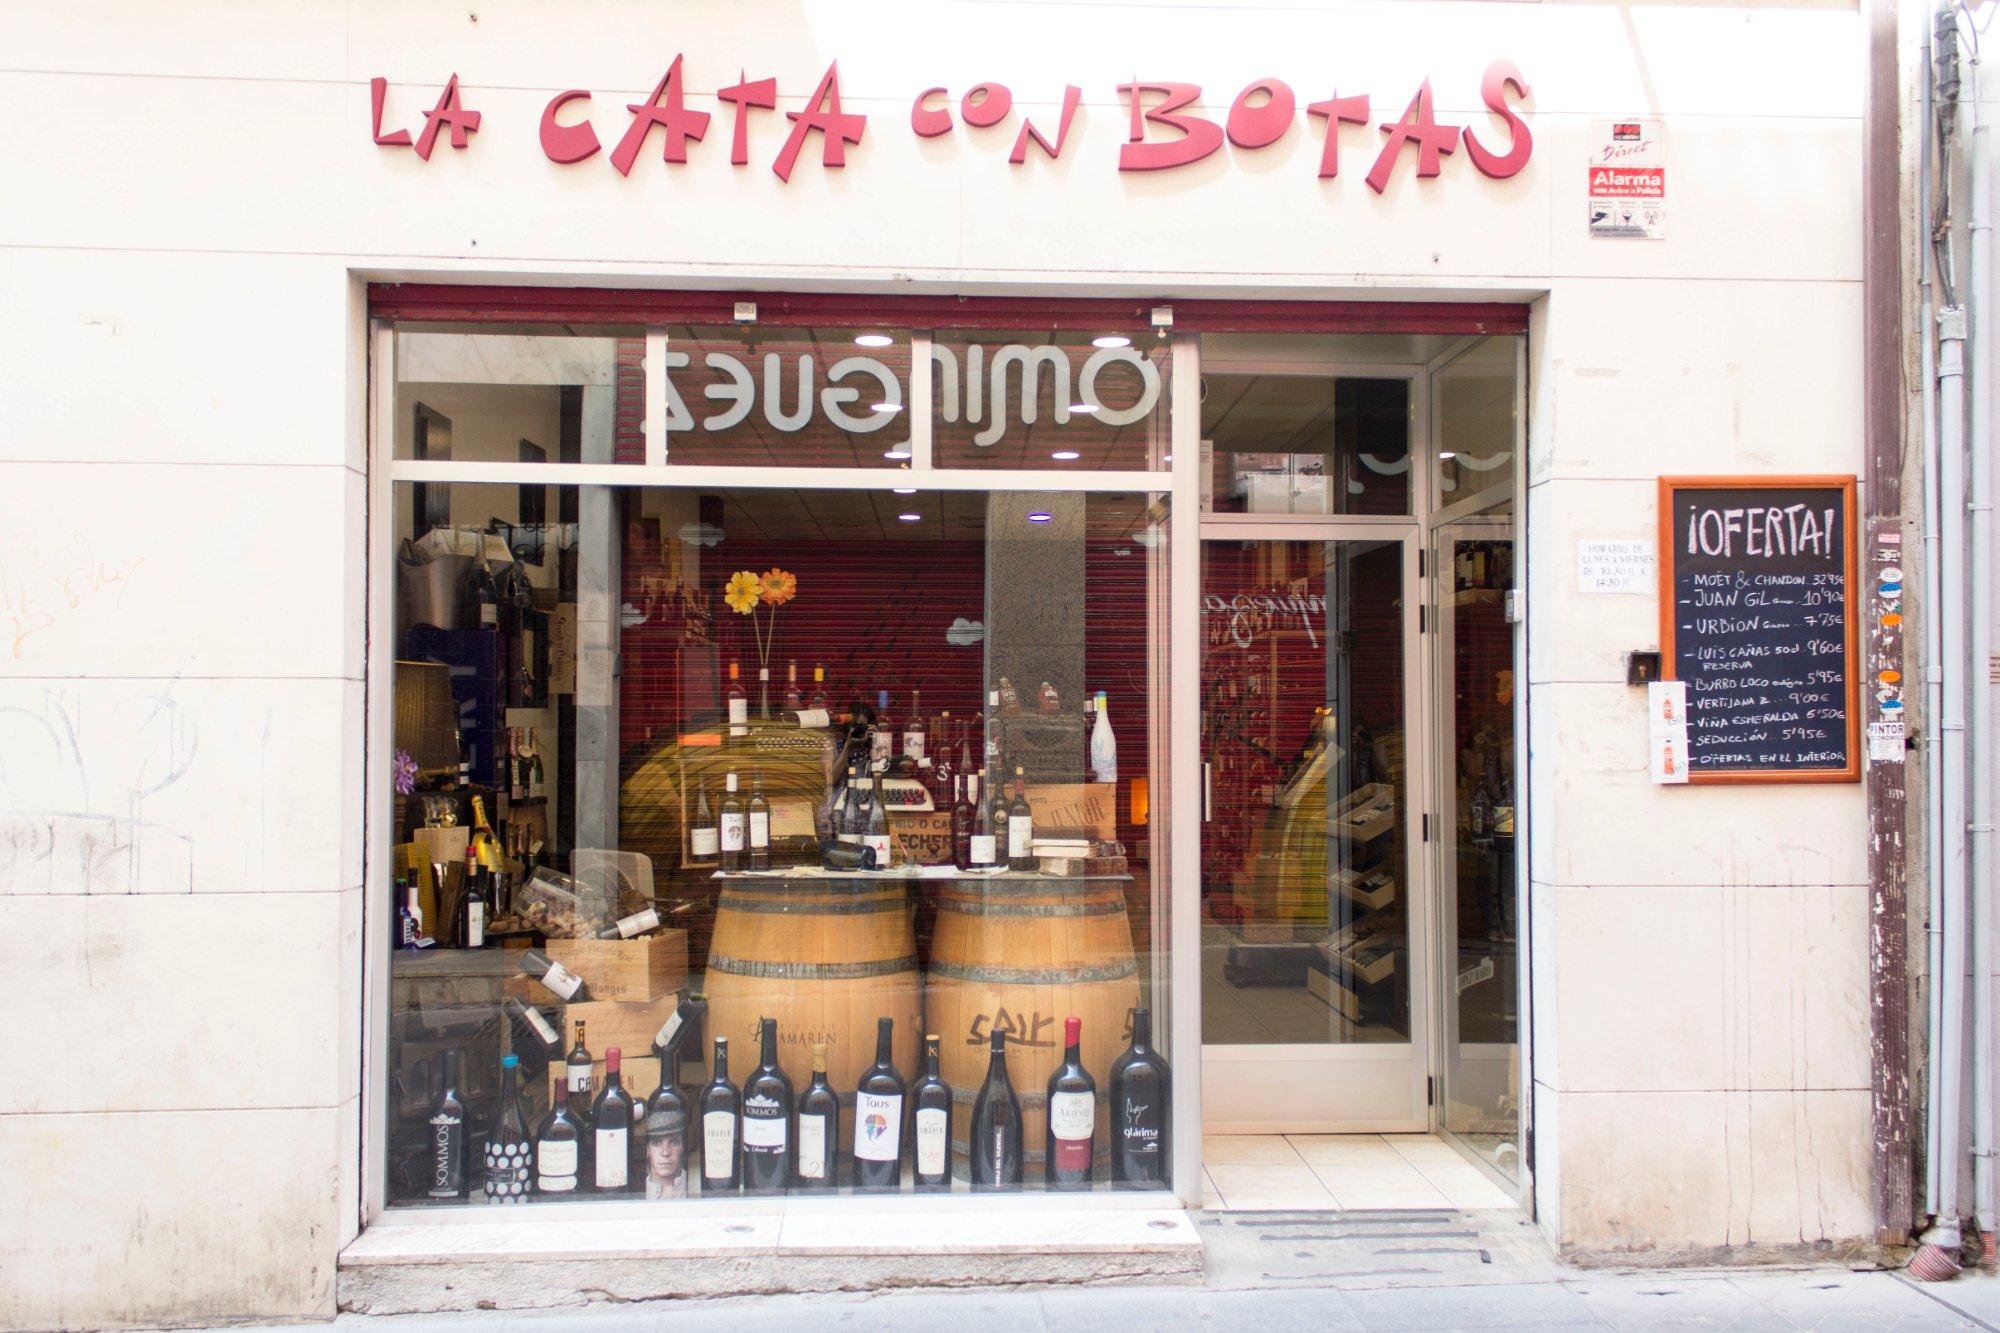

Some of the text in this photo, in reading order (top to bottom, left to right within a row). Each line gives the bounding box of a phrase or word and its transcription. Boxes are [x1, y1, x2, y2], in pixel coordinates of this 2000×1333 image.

[370, 53, 1534, 195] LA CATA CON BOTAS
[1593, 170, 1661, 187] Alarma
[1688, 503, 1835, 560] ¡OFERTA!
[1735, 570, 1752, 589] &
[1694, 589, 1738, 607] JUAN
[1729, 643, 1771, 658] CAÑAS
[1703, 661, 1753, 672] RESERVA
[1696, 678, 1737, 692] BURRO
[1740, 677, 1770, 688] LOCO
[1870, 724, 1904, 734] PINTOR
[1760, 753, 1777, 763] EN
[1780, 753, 1791, 763] EL
[865, 1096, 890, 1109] Taus
[436, 1125, 449, 1187] SOMMOS
